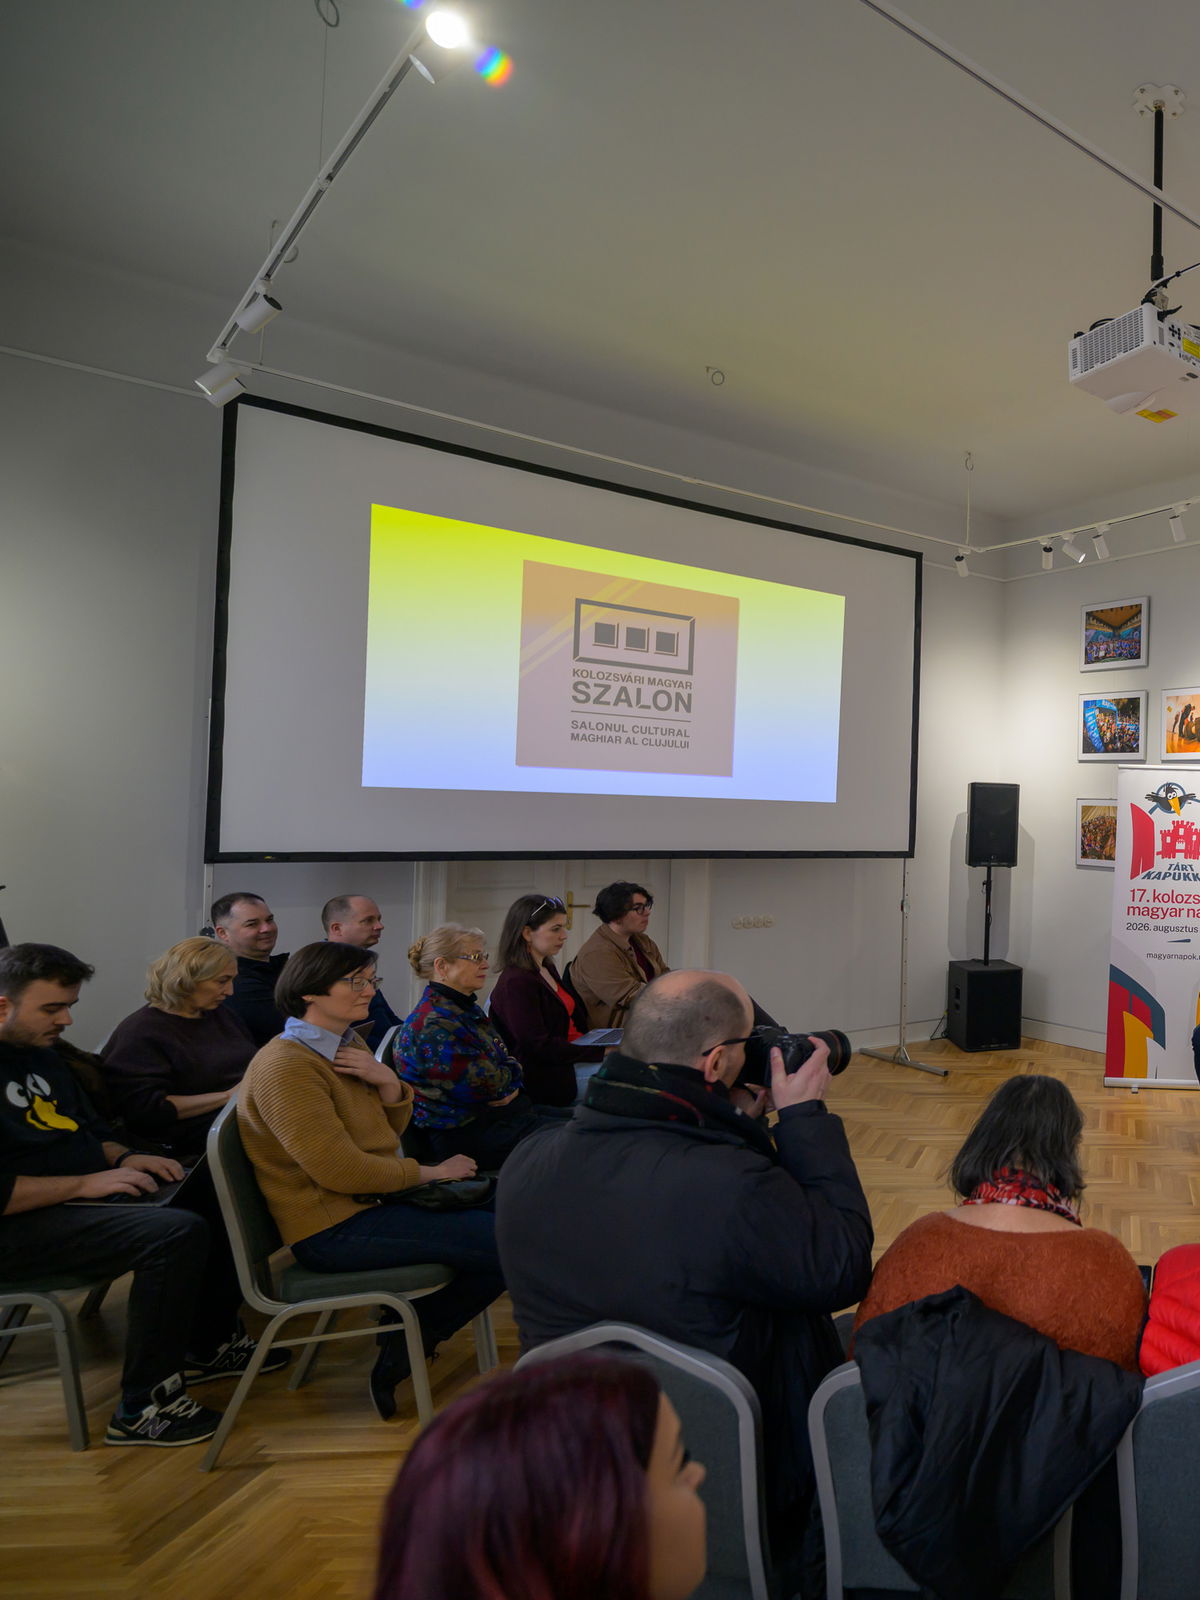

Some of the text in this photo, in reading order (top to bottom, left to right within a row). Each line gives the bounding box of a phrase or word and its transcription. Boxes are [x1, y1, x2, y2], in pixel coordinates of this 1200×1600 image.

[572, 668, 693, 690] KOLOZSVÁRI MAGYAR
[571, 680, 692, 713] SZALON
[571, 720, 690, 738] SALONUL CULTURAL
[570, 732, 690, 749] MAGHIAR AL CLUJULUI
[1167, 862, 1195, 872] TÁRT
[1130, 888, 1150, 903] 17.
[1127, 905, 1185, 920] magyar
[1126, 922, 1152, 932] 2026.
[1153, 924, 1199, 934] augusztus
[136, 1415, 172, 1440] N
